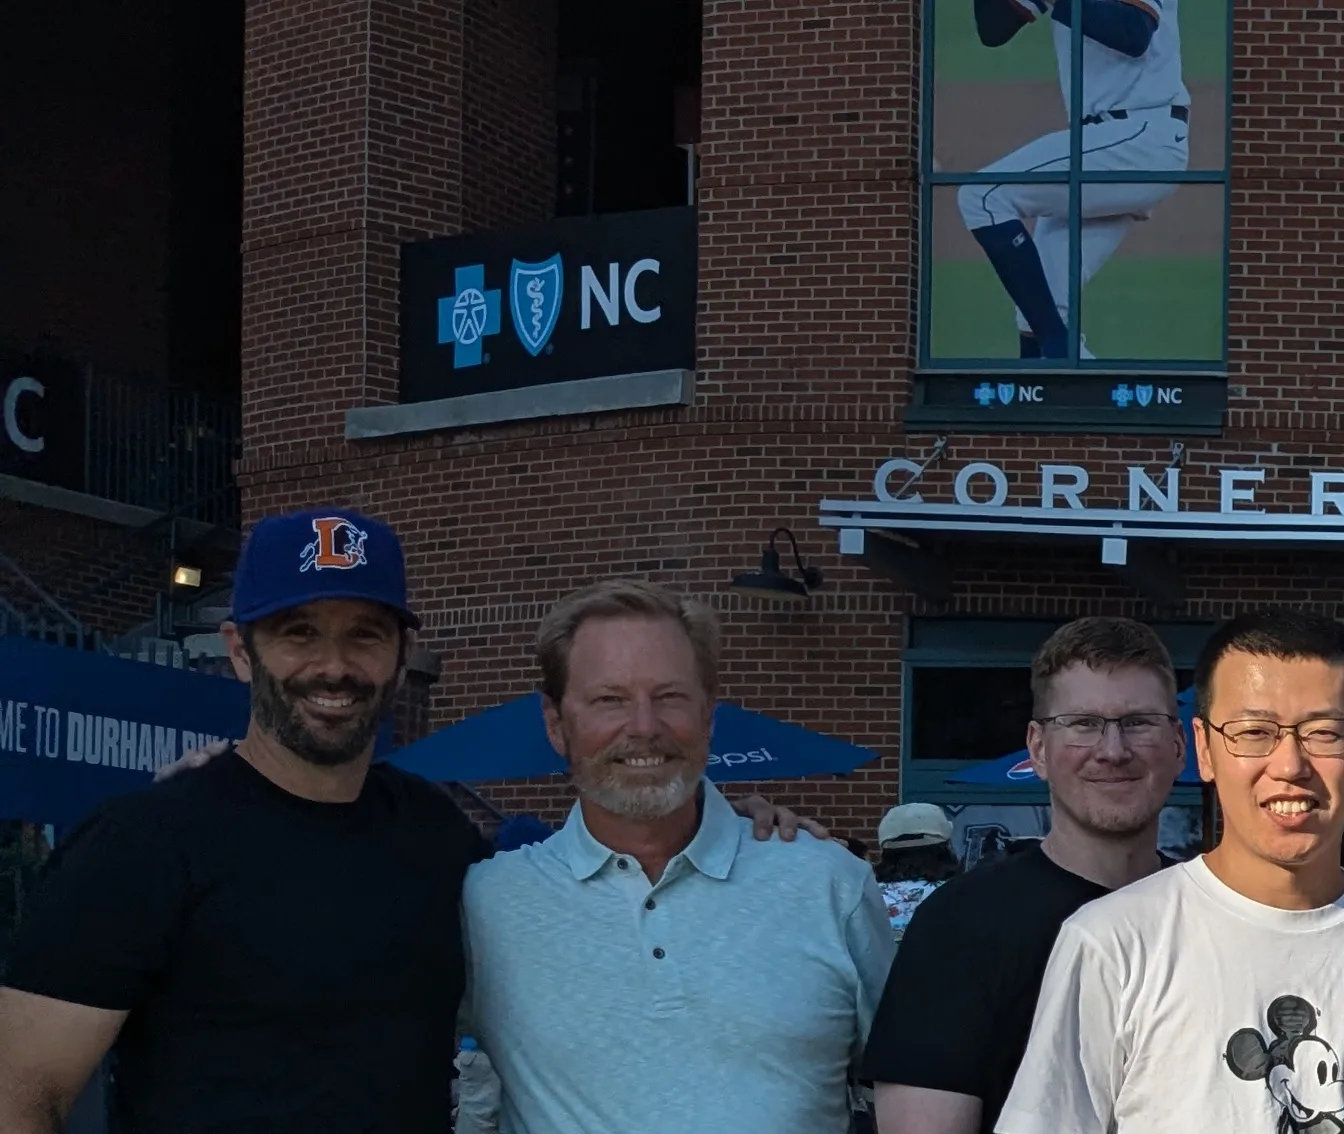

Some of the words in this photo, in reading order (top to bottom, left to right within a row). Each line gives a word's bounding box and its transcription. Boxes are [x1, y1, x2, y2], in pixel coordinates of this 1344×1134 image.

[581, 259, 661, 329] NC
[4, 376, 45, 452] C
[1019, 386, 1043, 402] NC
[1158, 388, 1182, 403] NC
[34, 705, 60, 758] TO
[67, 711, 176, 773] DURHAM
[707, 747, 774, 767] epsi
